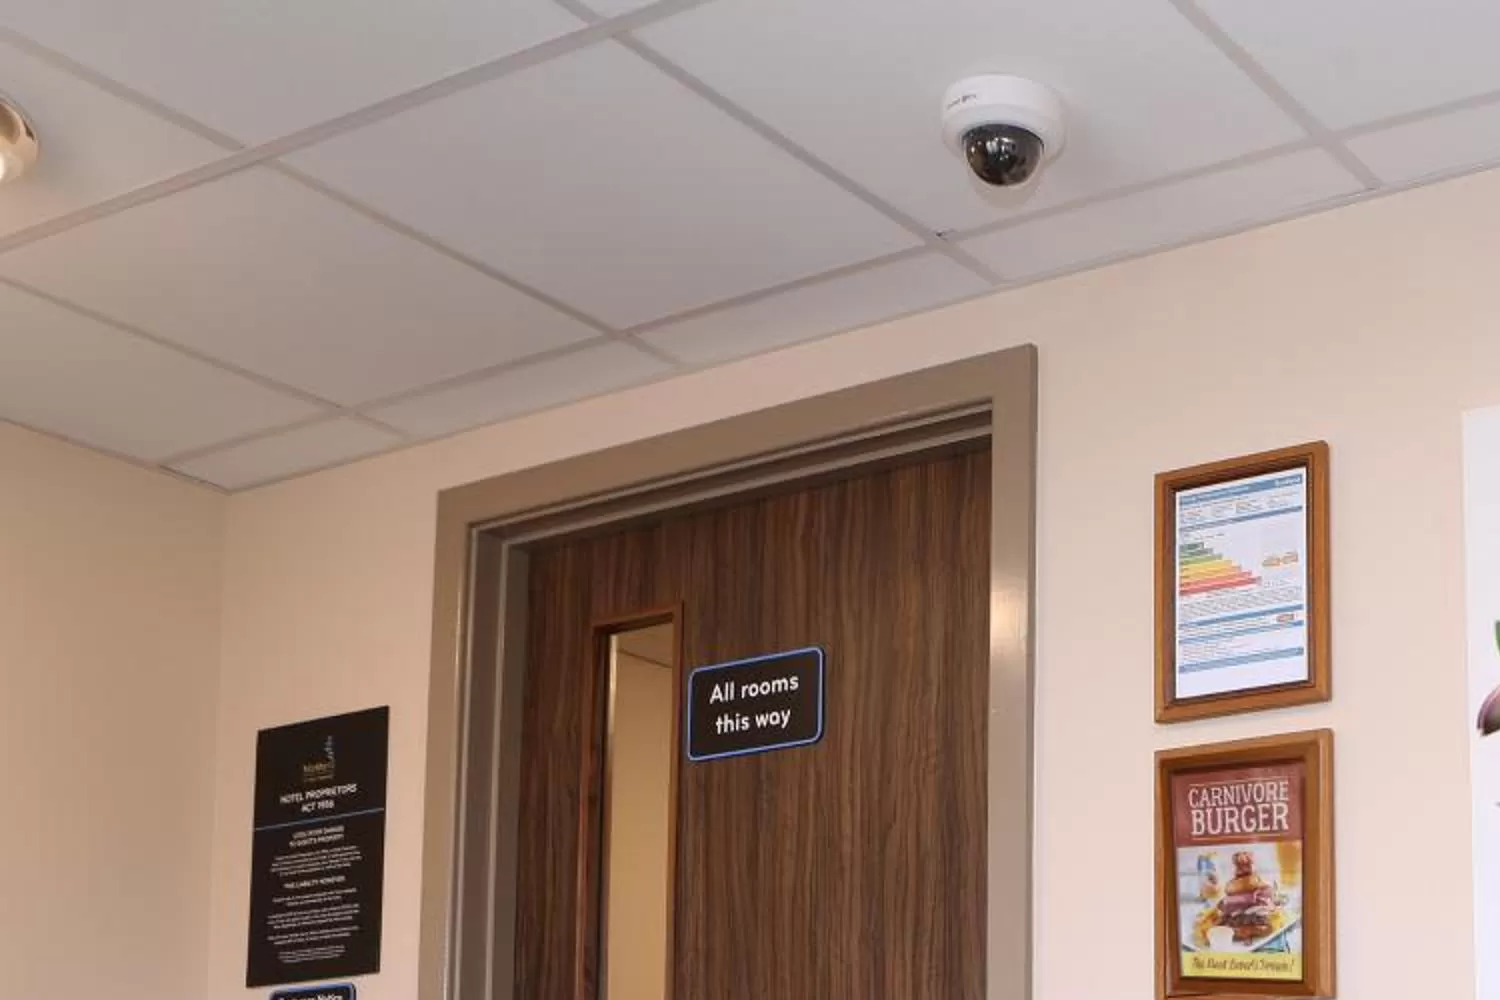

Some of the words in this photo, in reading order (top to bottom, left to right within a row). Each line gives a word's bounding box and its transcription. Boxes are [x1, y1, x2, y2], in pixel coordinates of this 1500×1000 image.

[710, 681, 735, 704] All
[741, 675, 799, 699] rooms
[715, 713, 750, 735] this
[755, 709, 791, 729] way
[280, 792, 304, 804] HOTEL
[305, 783, 357, 799] PROPRIETORS
[1188, 781, 1289, 808] CARNIVORE
[301, 801, 316, 813] ACT
[1190, 803, 1289, 836] BURGER
